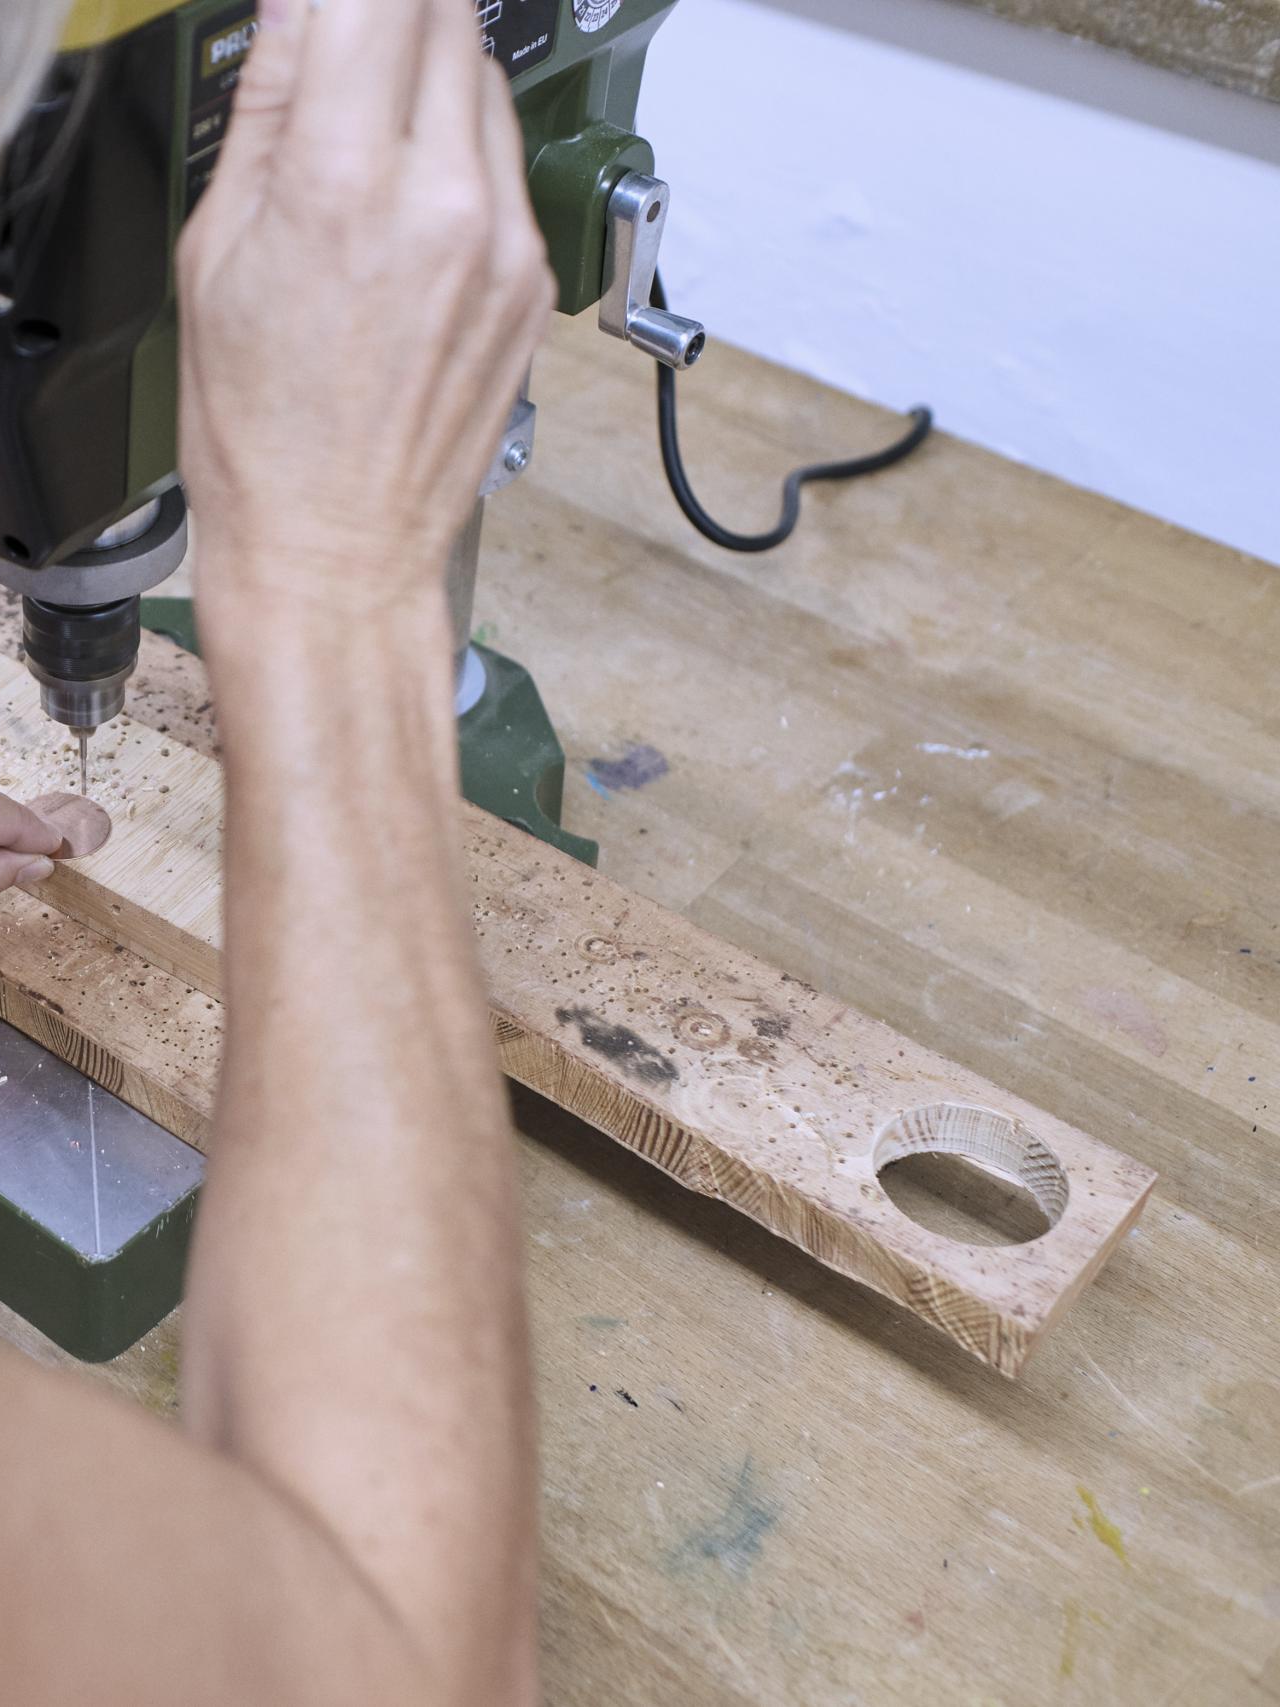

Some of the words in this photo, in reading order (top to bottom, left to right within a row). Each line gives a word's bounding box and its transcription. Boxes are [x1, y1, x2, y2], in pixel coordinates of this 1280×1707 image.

[512, 45, 530, 61] Made
[530, 41, 537, 50] in
[537, 33, 548, 46] EU
